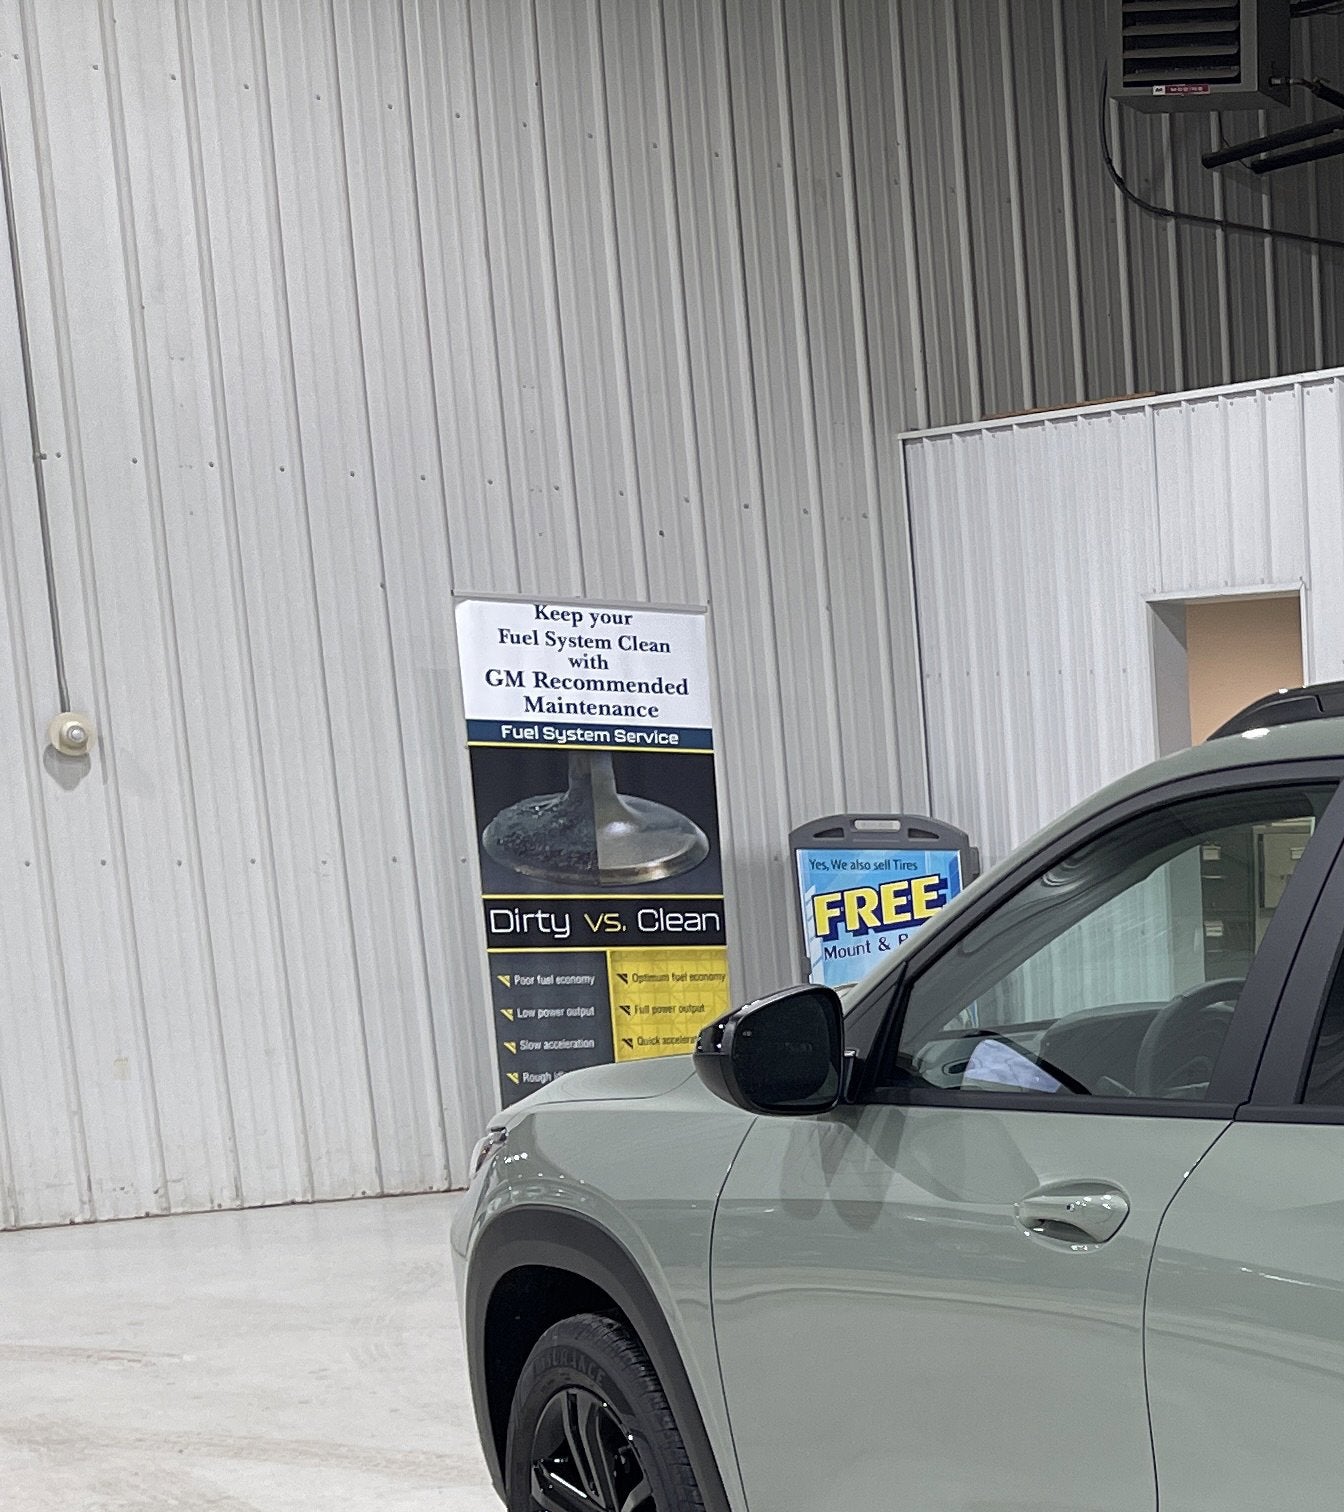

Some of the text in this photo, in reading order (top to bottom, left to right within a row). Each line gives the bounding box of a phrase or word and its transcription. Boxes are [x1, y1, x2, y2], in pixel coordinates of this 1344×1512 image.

[533, 603, 634, 629] Keep your
[498, 628, 672, 654] Fuel System Clean
[568, 653, 610, 671] with
[484, 668, 690, 697] GM Recommended
[523, 695, 660, 719] Maintenance
[501, 724, 680, 746] Fuel System Service
[808, 859, 918, 871] Yes, We also sell Tires
[812, 875, 944, 938] FREE
[489, 907, 721, 939] Dirty vs. Clean
[823, 939, 872, 961] Mount
[878, 936, 891, 952] &
[514, 974, 596, 988] Poor fuel economy
[632, 972, 726, 984] Optimum fuel economy
[517, 1006, 595, 1020] Low power output
[634, 1003, 705, 1016] Full power output
[519, 1038, 595, 1051] Slow acceleration
[637, 1035, 661, 1046] Quick
[522, 1072, 552, 1085] Rough
